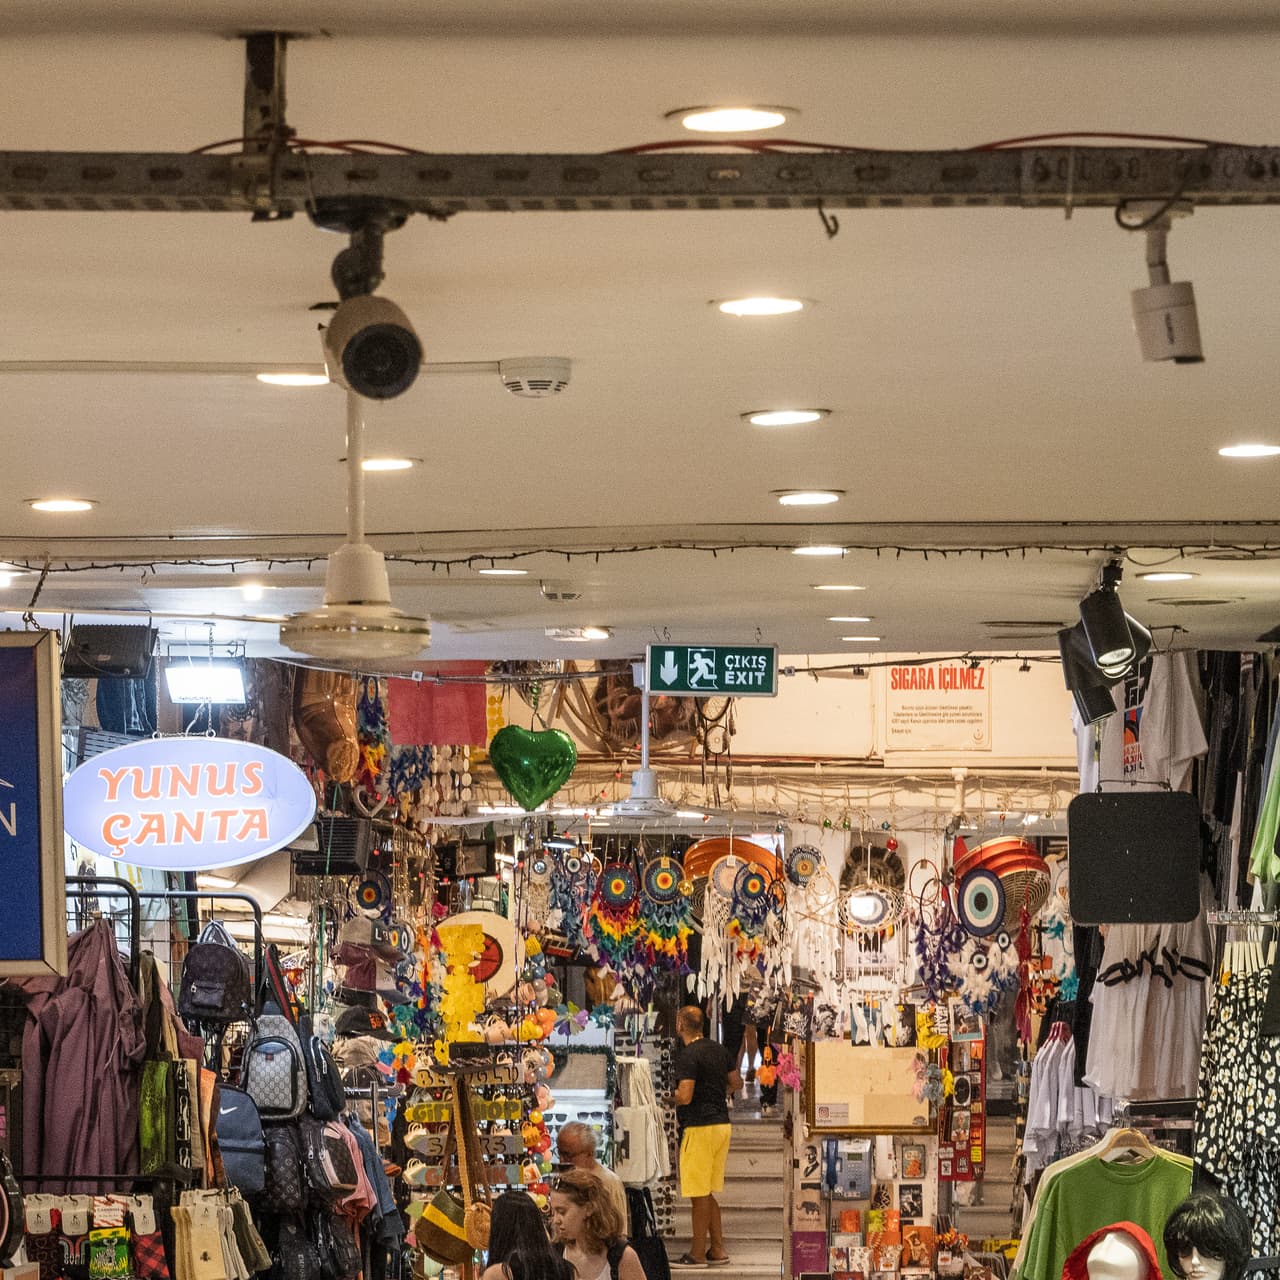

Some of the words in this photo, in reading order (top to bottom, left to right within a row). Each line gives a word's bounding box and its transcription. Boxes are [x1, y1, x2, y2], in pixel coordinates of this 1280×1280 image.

[725, 655, 767, 671] ÇIKIŞ
[725, 671, 765, 685] EXIT
[938, 664, 985, 693] İÇİLMEZ
[98, 762, 263, 802] YUNUS
[102, 806, 270, 857] ÇANTA
